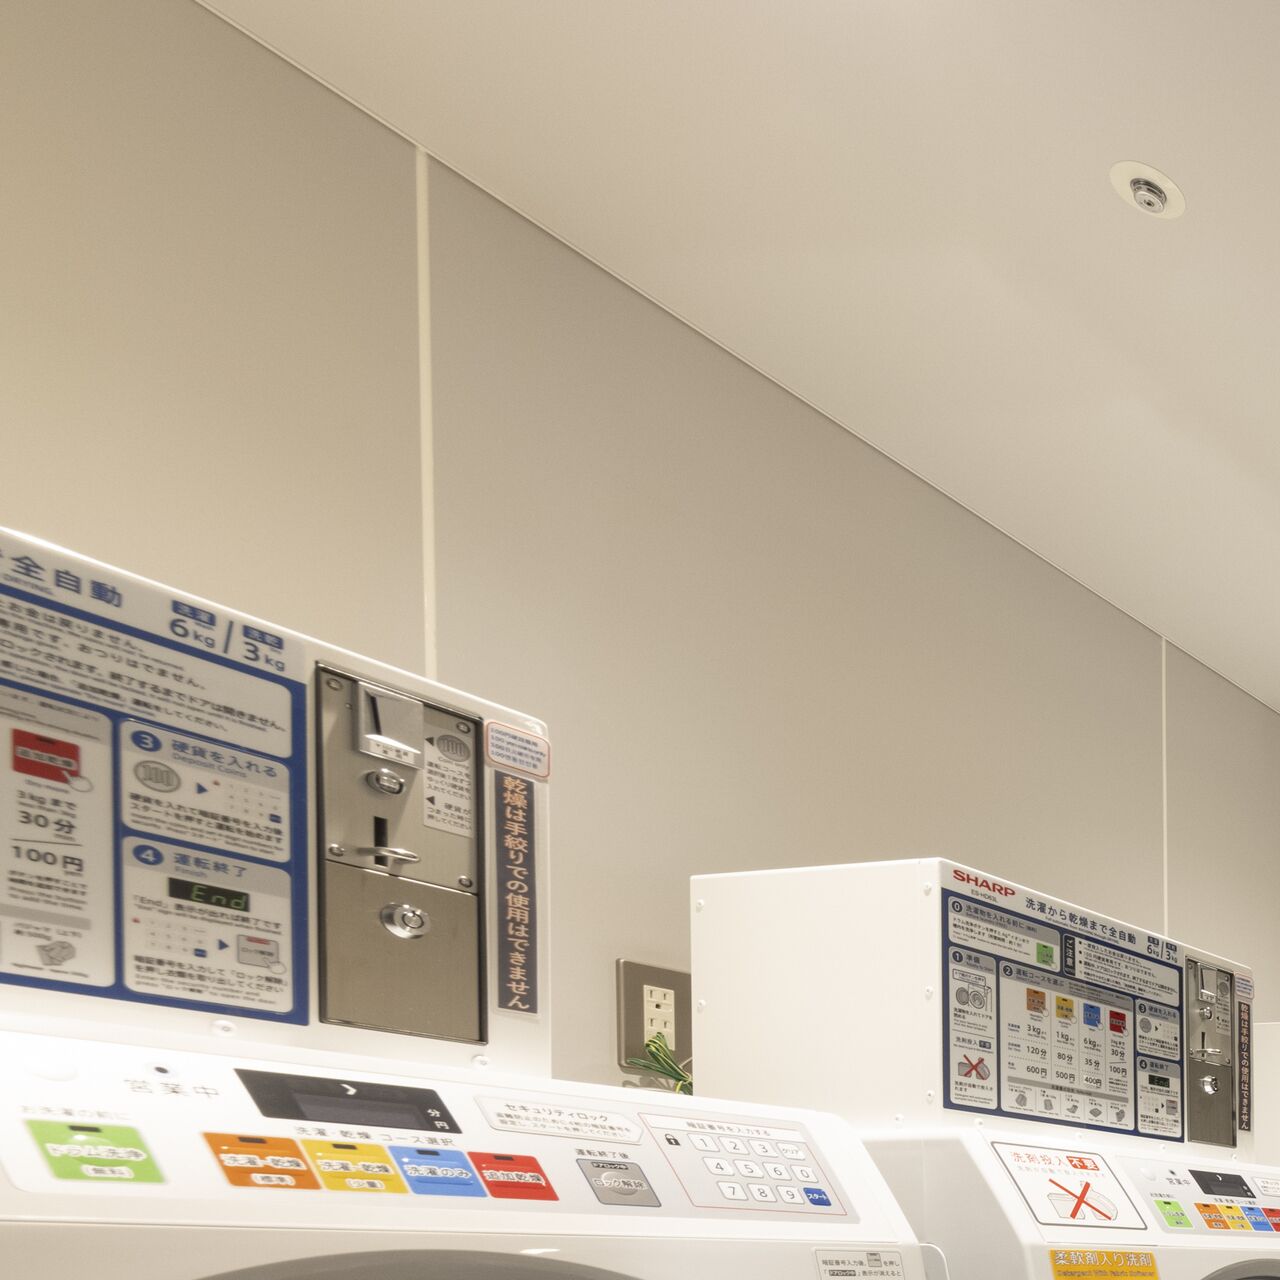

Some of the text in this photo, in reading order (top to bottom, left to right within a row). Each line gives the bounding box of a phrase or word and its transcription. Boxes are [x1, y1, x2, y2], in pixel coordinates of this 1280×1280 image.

[0, 551, 122, 609] 全自動
[172, 737, 277, 781] 硬貨を入れる
[503, 776, 530, 1010] 乾燥は手絞りでの使用はできません
[952, 868, 1015, 900] SHARP
[1025, 896, 1136, 945] 洗濯から乾燥まで全自動
[504, 1103, 609, 1122] セキュリティロック
[1071, 1157, 1099, 1170] 不要
[808, 1192, 828, 1201] スタート
[1055, 1252, 1152, 1267] 柔軟剤入り洗剤
